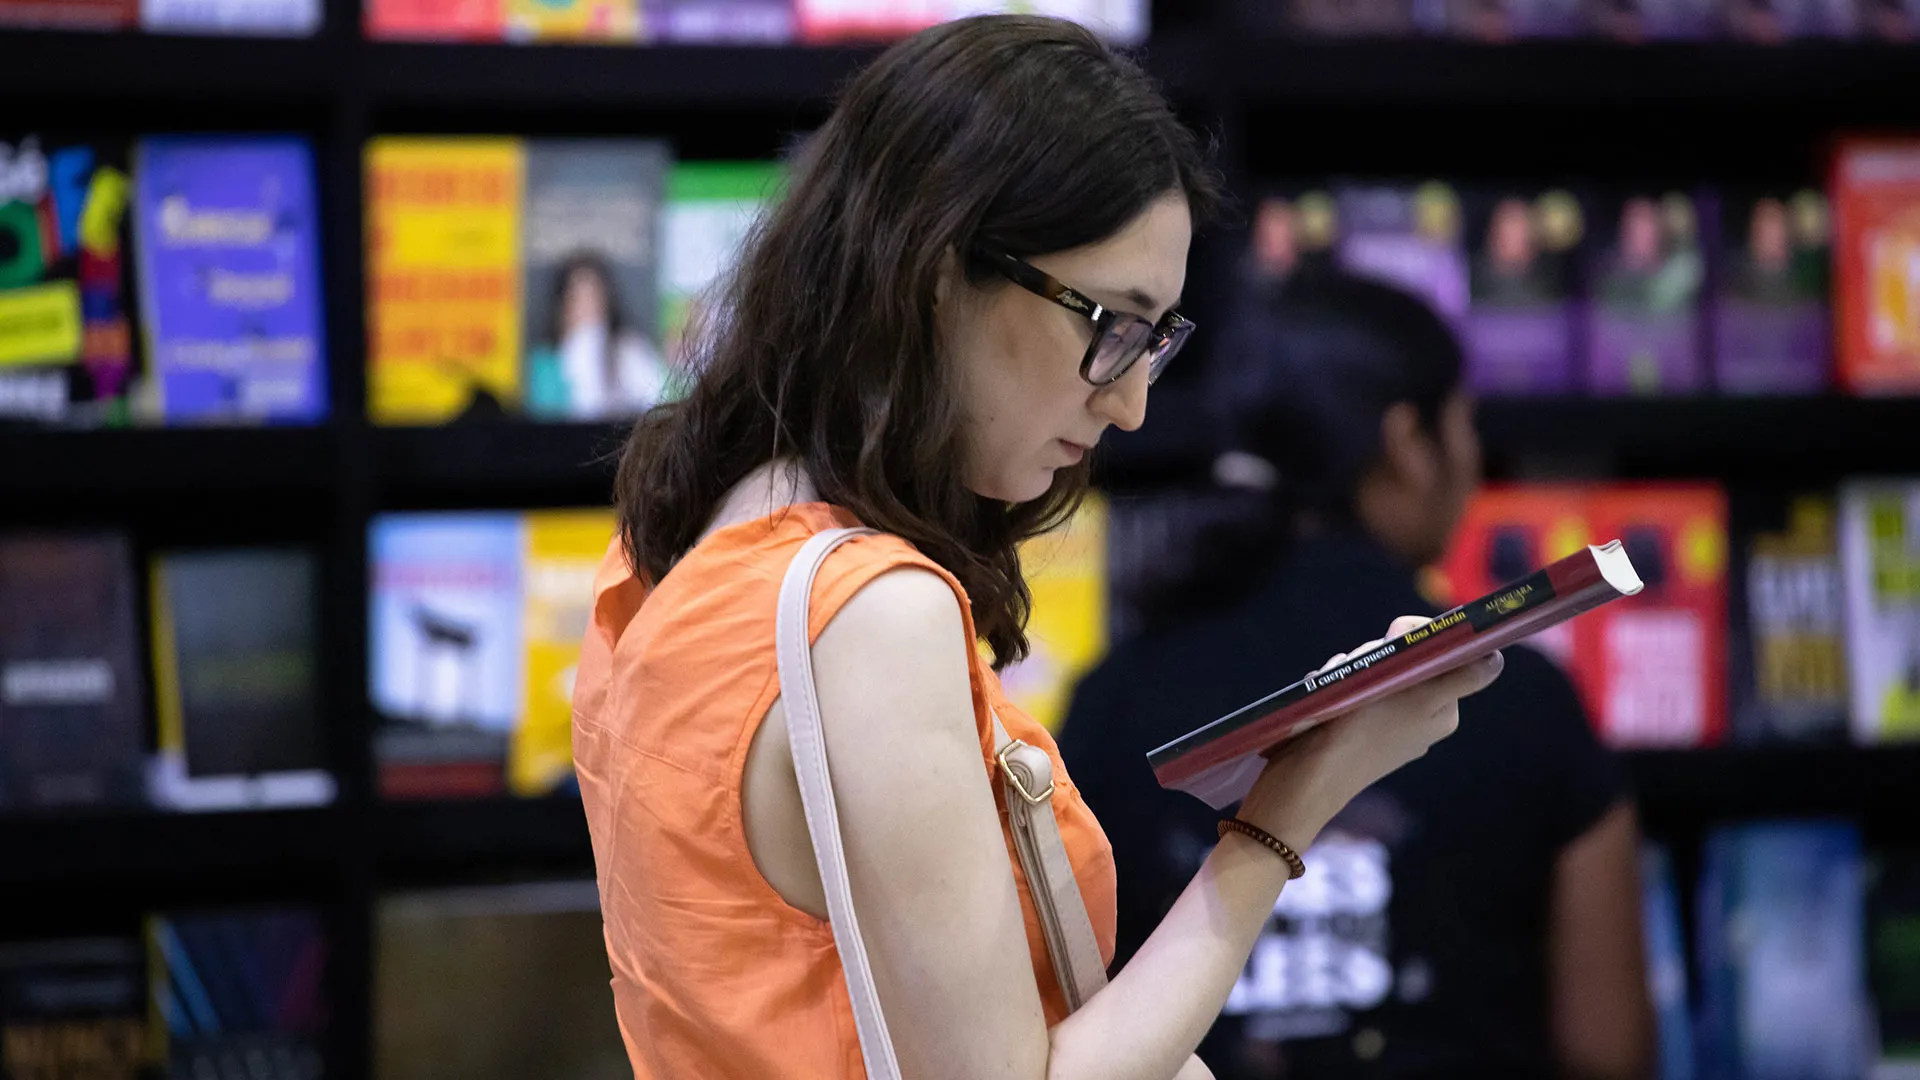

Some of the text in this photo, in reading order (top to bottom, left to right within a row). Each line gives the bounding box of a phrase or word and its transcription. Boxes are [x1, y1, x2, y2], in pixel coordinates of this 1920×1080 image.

[1485, 584, 1533, 612] ALFAGUARA
[1404, 610, 1467, 645] Rosa Beltrán
[1304, 644, 1396, 692] El cuerpo expuesto
